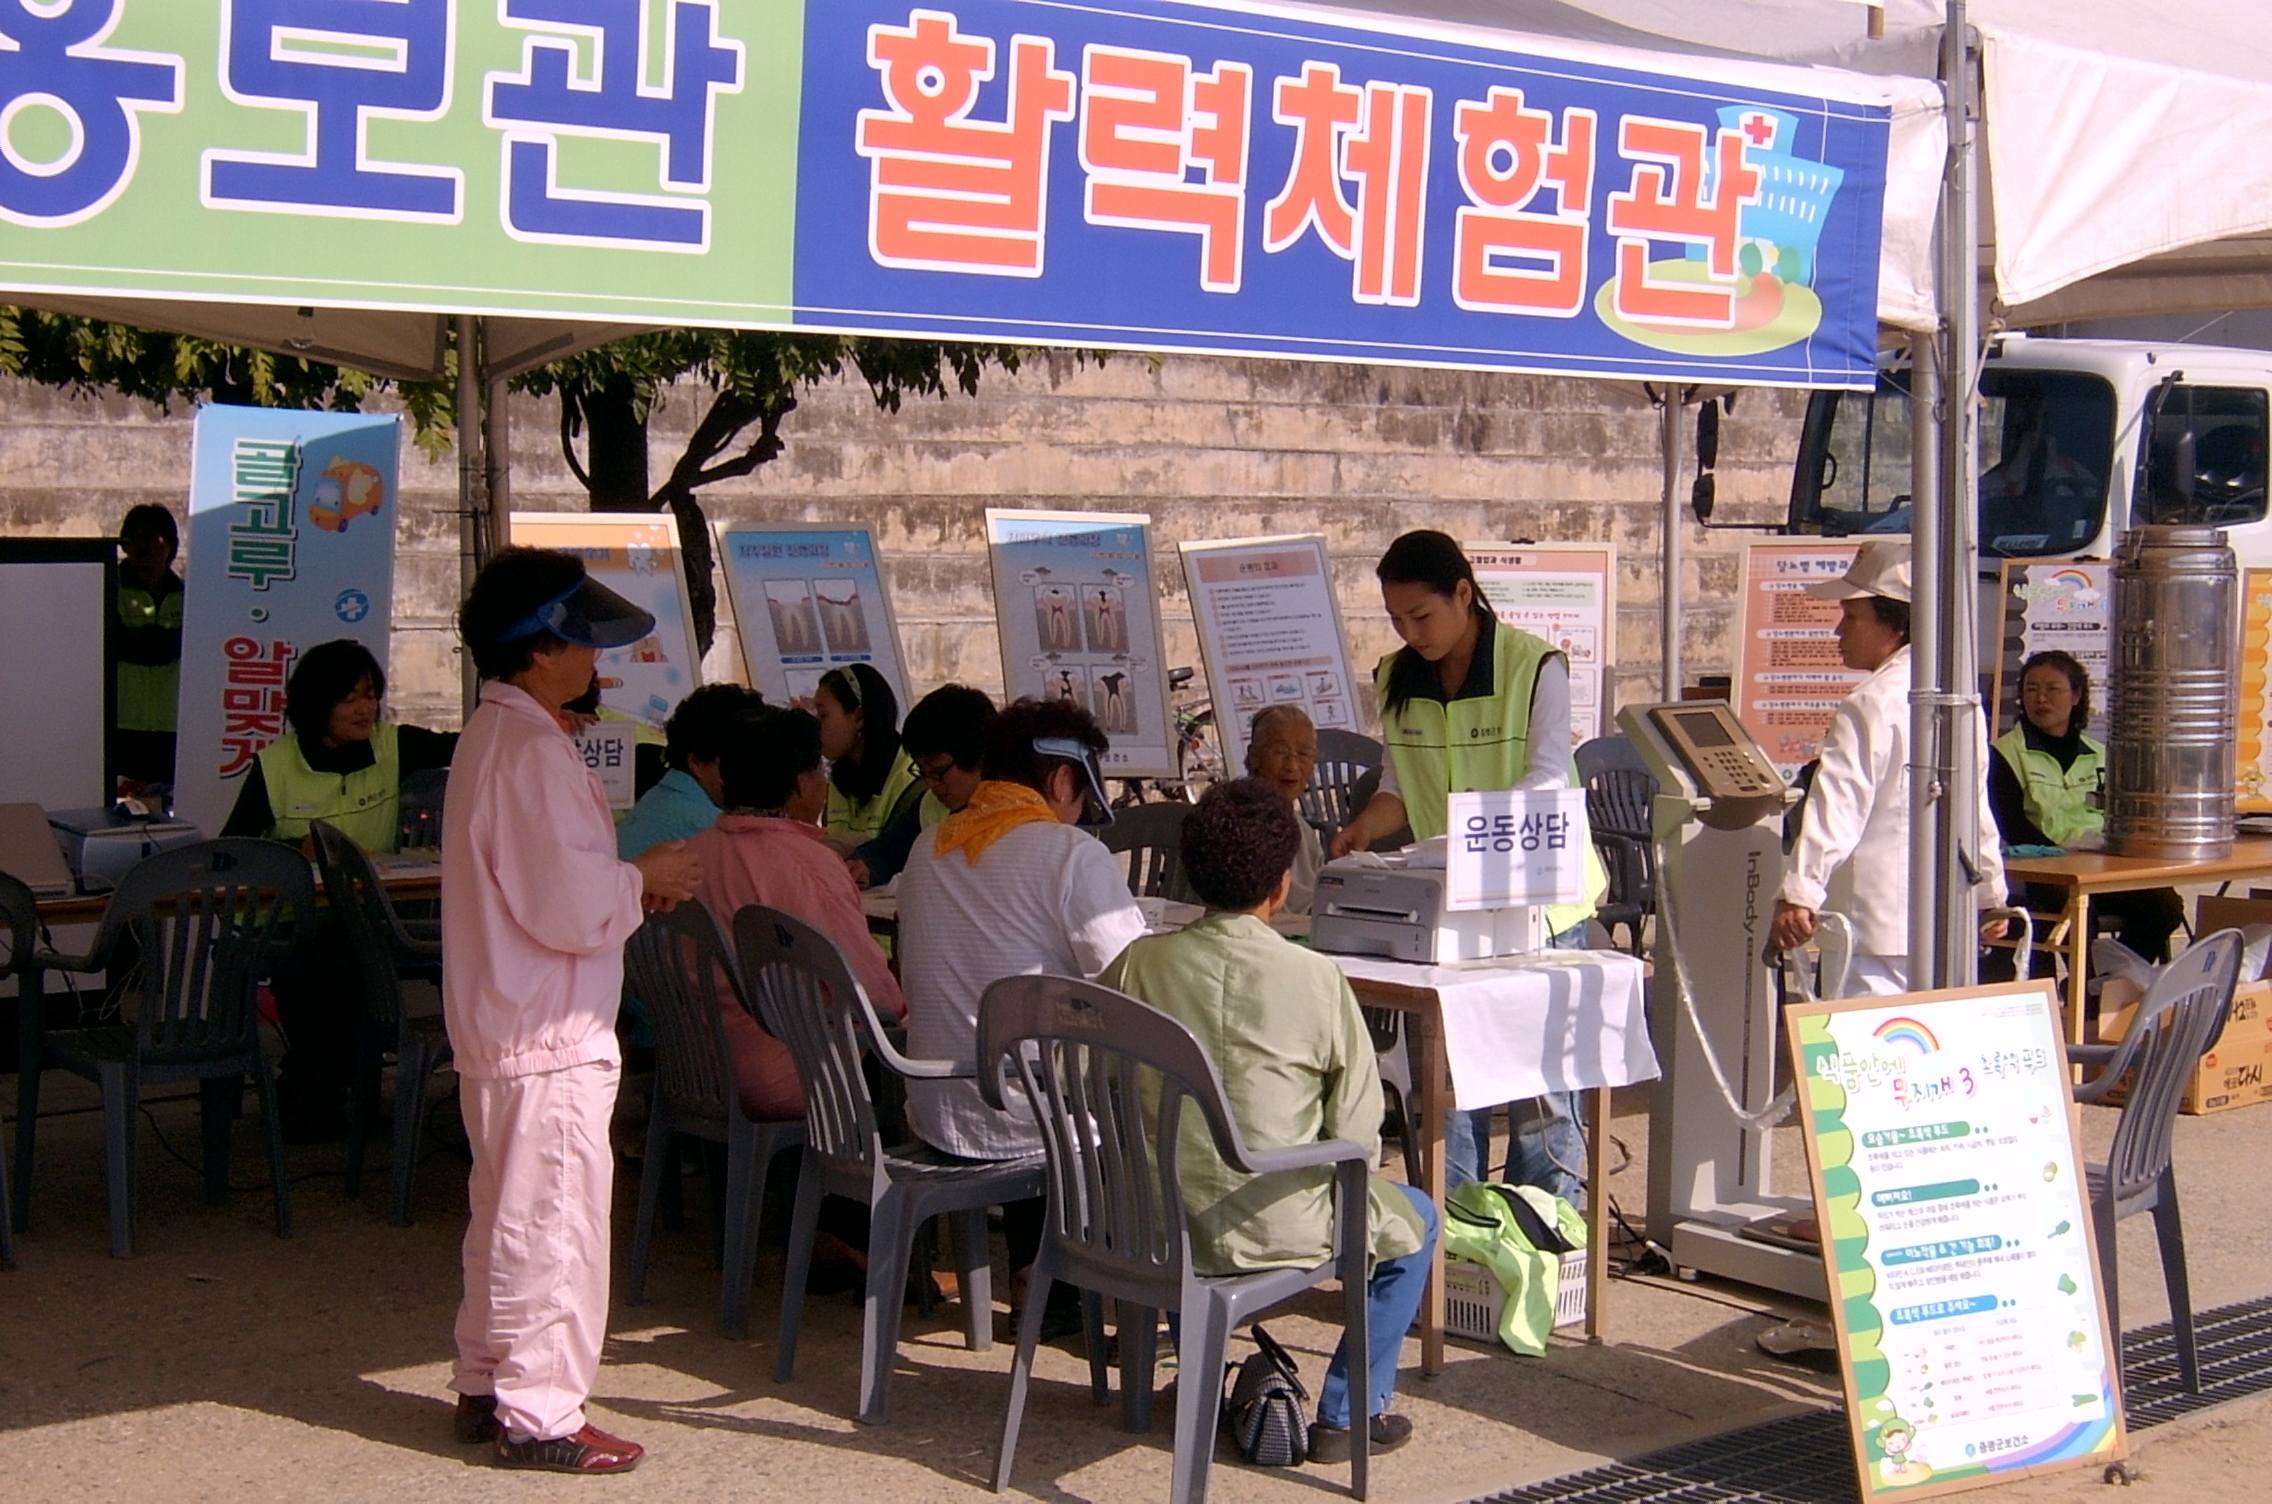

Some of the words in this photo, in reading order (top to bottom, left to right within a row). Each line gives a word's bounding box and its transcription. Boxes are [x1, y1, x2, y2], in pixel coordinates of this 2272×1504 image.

[855, 8, 1761, 330] 활력체험관
[227, 438, 302, 592] 골고루
[575, 738, 624, 768] 상담
[1464, 811, 1570, 853] 운동상담
[1743, 850, 1762, 936] InBody
[1816, 1052, 1907, 1095] 식품안에
[1893, 1076, 1955, 1111] 무지개
[1958, 1067, 1977, 1098] 3
